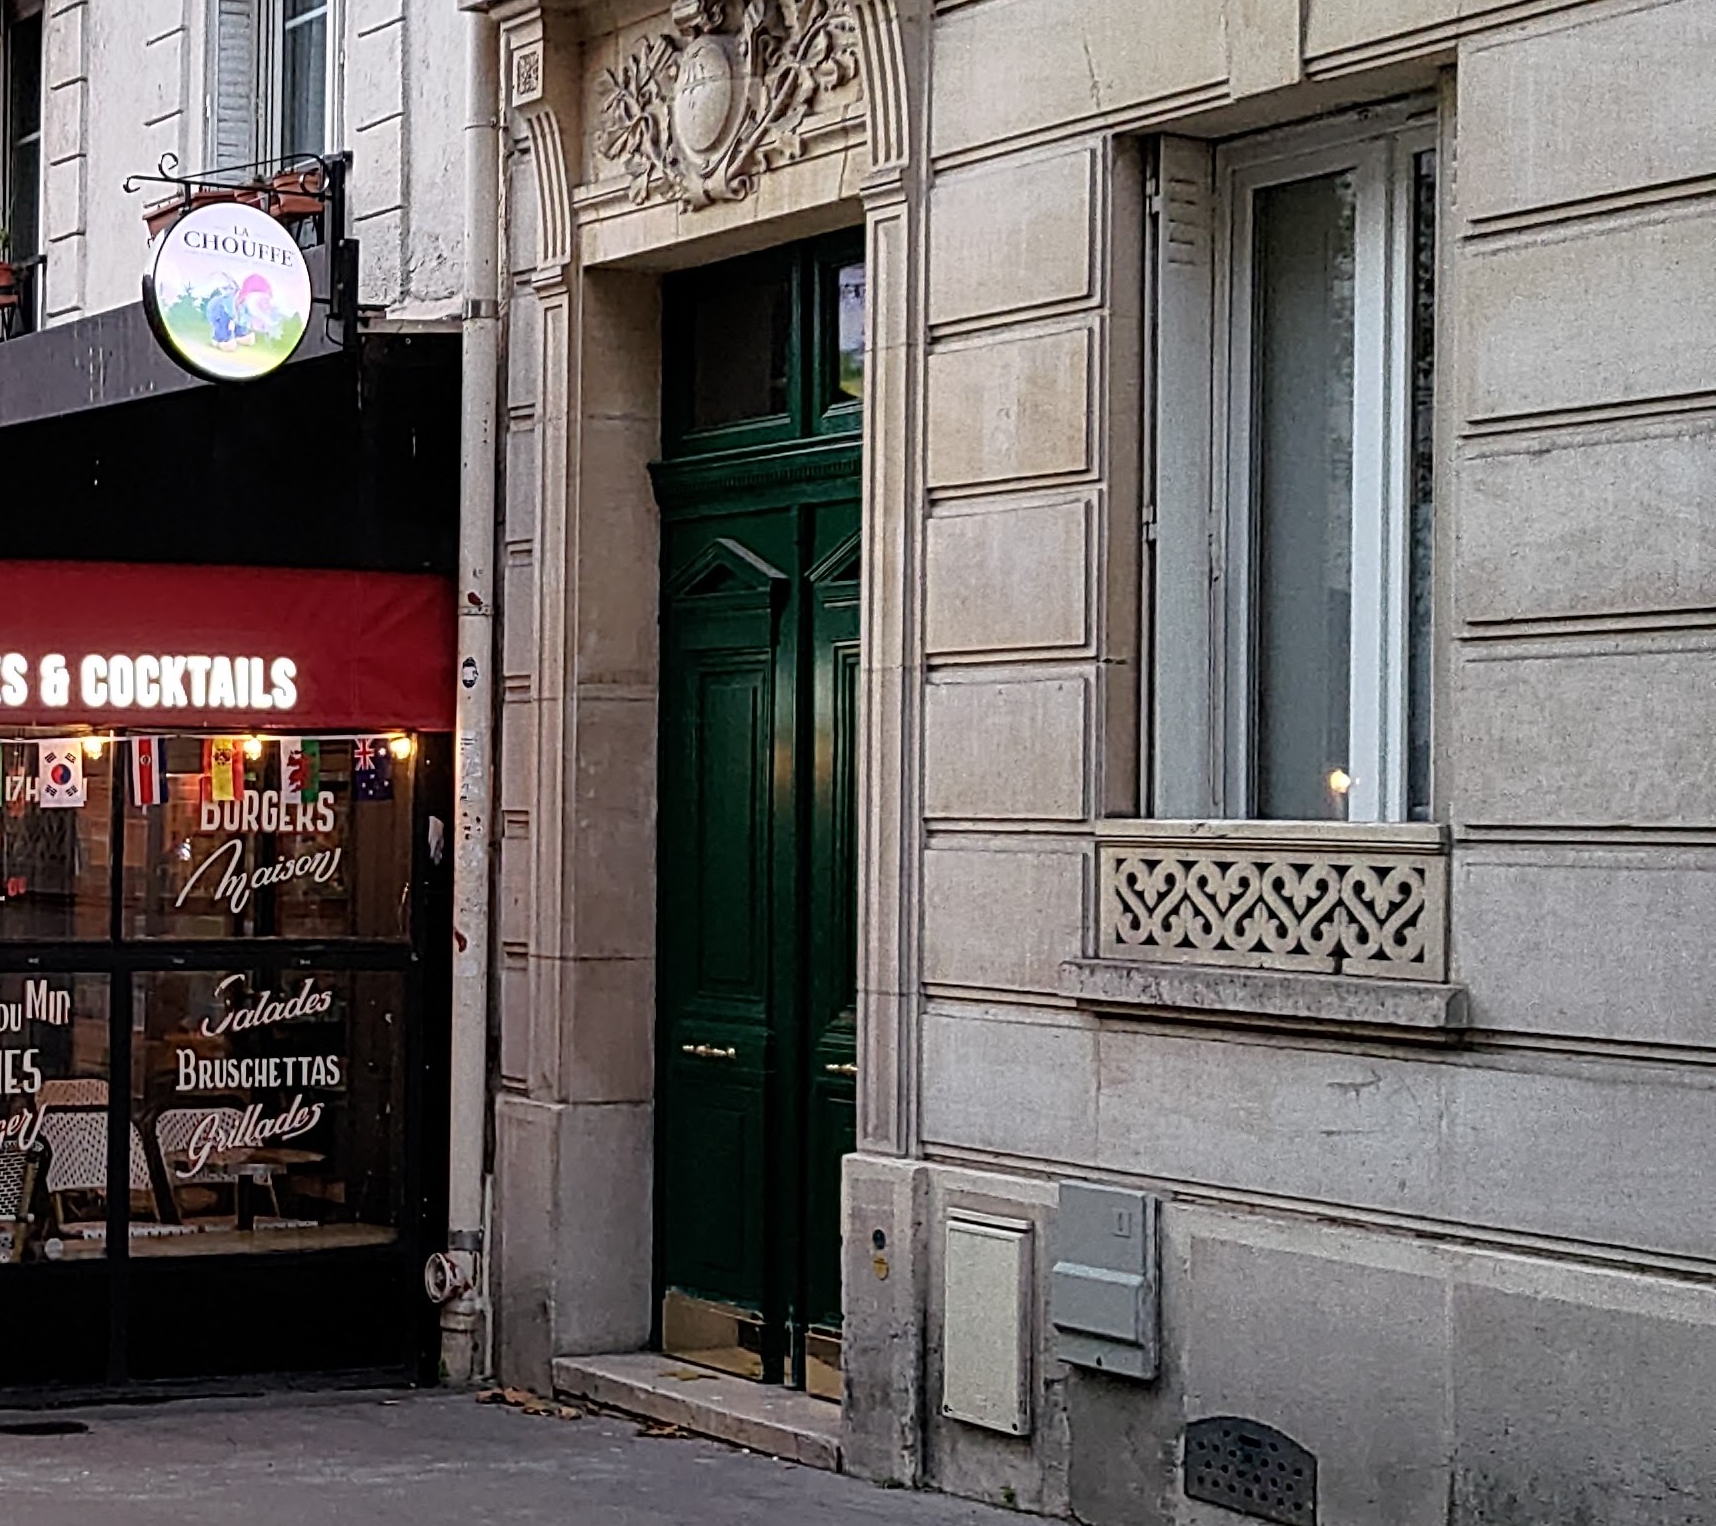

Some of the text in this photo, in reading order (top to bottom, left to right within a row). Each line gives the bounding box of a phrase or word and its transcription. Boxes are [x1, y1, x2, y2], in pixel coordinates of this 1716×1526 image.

[183, 230, 294, 268] CHOUFFE
[233, 225, 249, 238] LA
[38, 654, 70, 707] &
[81, 653, 298, 710] COCKTAILS
[200, 790, 335, 832] BURGERS
[175, 839, 342, 914] Maison
[201, 974, 333, 1037] Salades
[175, 1048, 341, 1091] BRUSCHETTAS
[175, 1093, 325, 1178] Grillades
